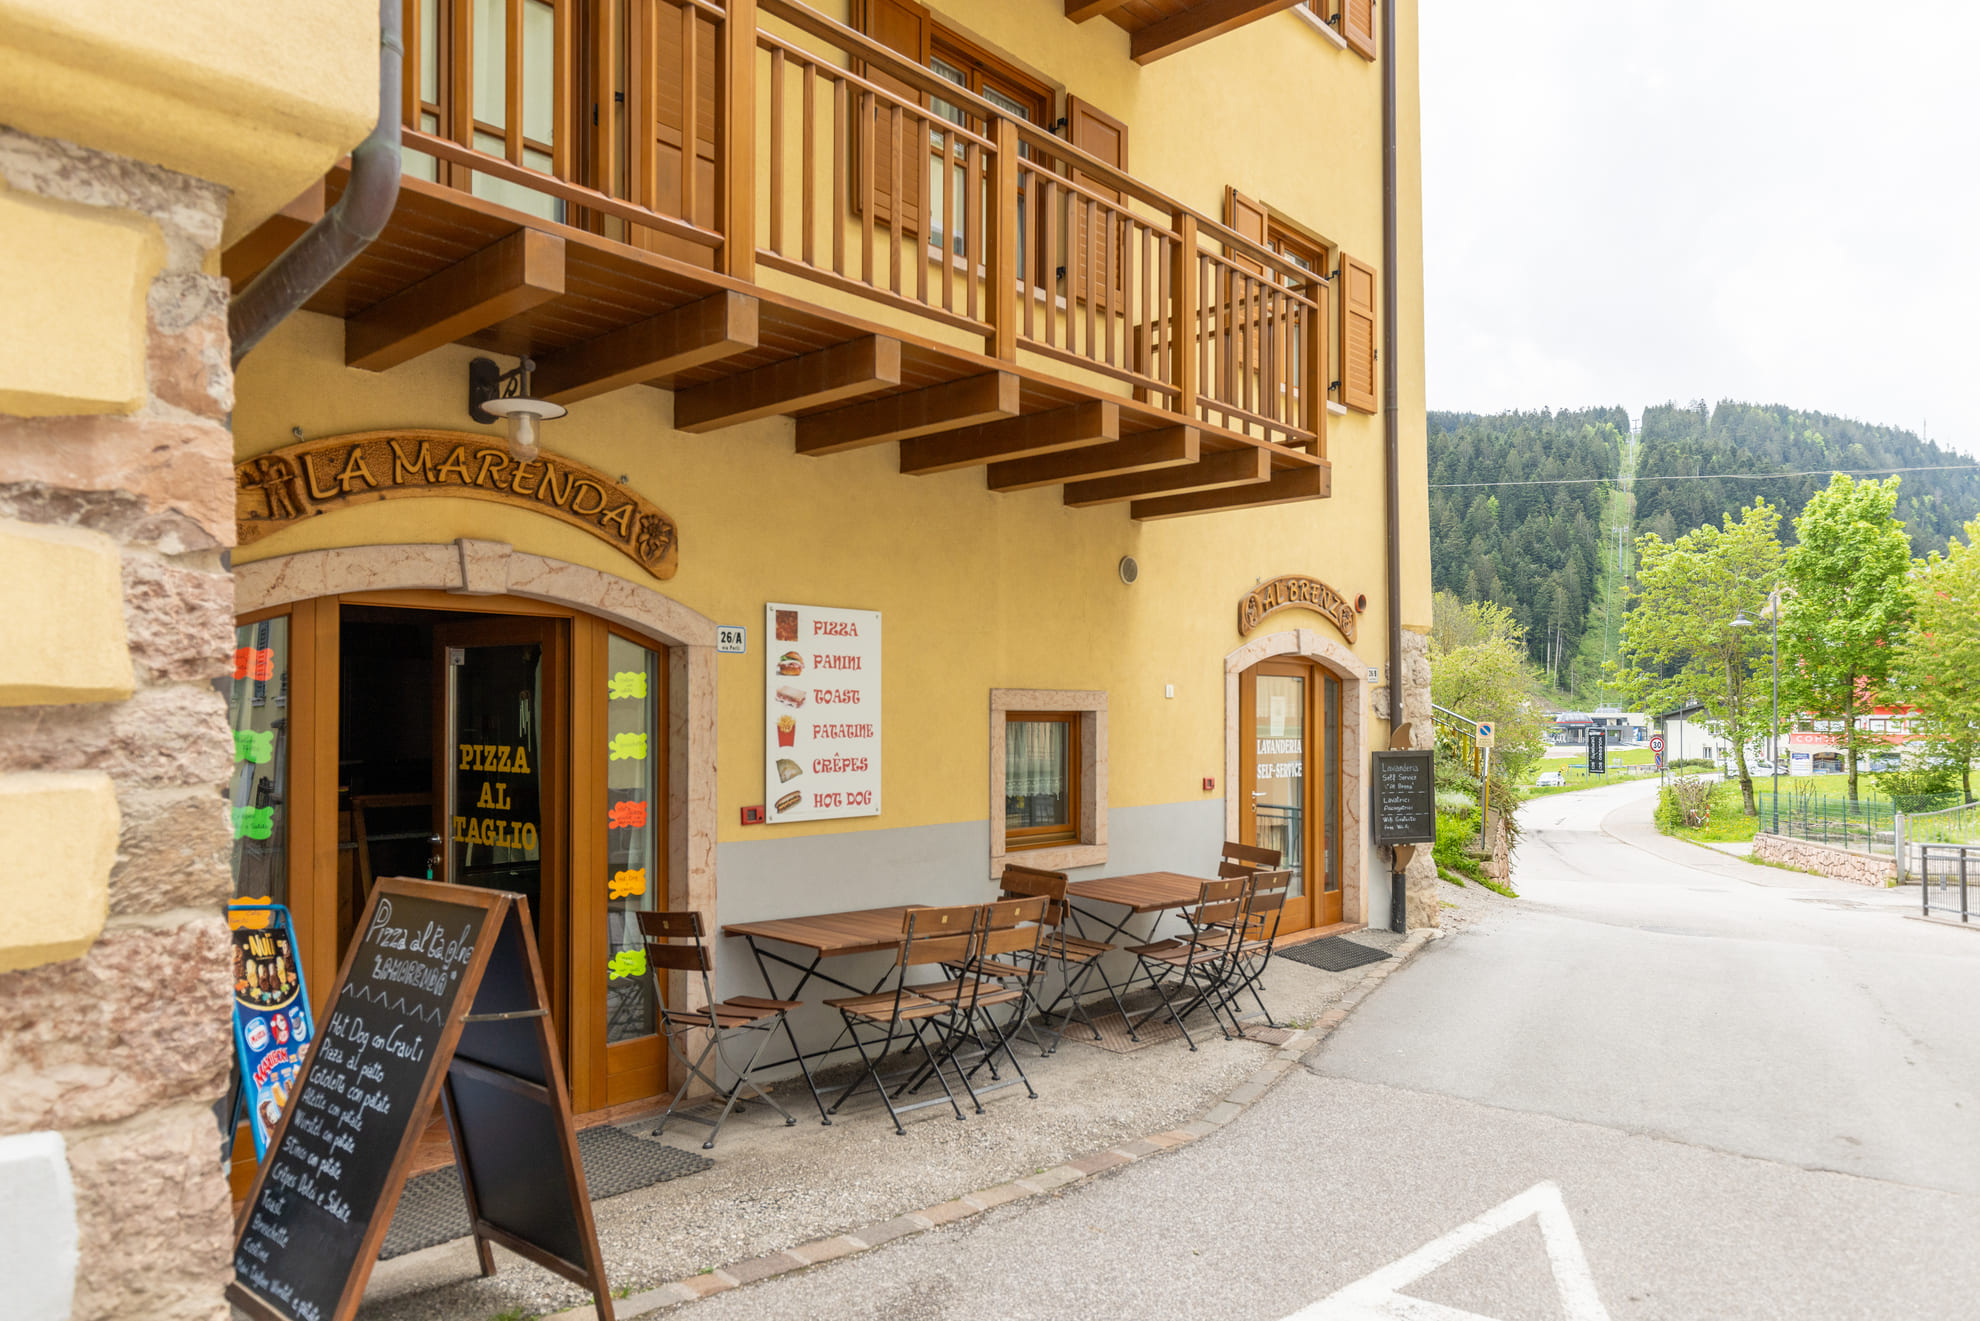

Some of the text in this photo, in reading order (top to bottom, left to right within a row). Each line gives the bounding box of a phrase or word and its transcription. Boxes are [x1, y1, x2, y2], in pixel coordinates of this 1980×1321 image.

[303, 438, 641, 538] LA MARENDA
[1263, 580, 1341, 619] AL BRENZ
[813, 620, 858, 637] PIZZA
[720, 631, 742, 644] 26/A
[813, 654, 862, 671] PANINI
[813, 688, 861, 704] TOAST
[812, 723, 874, 739] PATATINE
[1256, 739, 1302, 755] LAVANDERIA
[1653, 741, 1662, 749] 30
[459, 744, 531, 774] PIZZA
[812, 752, 868, 774] CRÊPES
[1381, 762, 1419, 772] Lavanderia
[1256, 762, 1303, 779] SELF-SERVICE
[1399, 773, 1417, 781] Service
[477, 782, 511, 810] AL
[813, 790, 872, 808] HOT DOG
[453, 815, 537, 851] TAGLIO
[365, 898, 408, 950] Pizza
[409, 920, 434, 952] al
[328, 1011, 424, 1062] Hot Dog con Crauti
[319, 1037, 344, 1064] Pizza
[346, 1052, 361, 1071] al
[253, 1047, 289, 1091] MAXIBON
[346, 1086, 364, 1103] con
